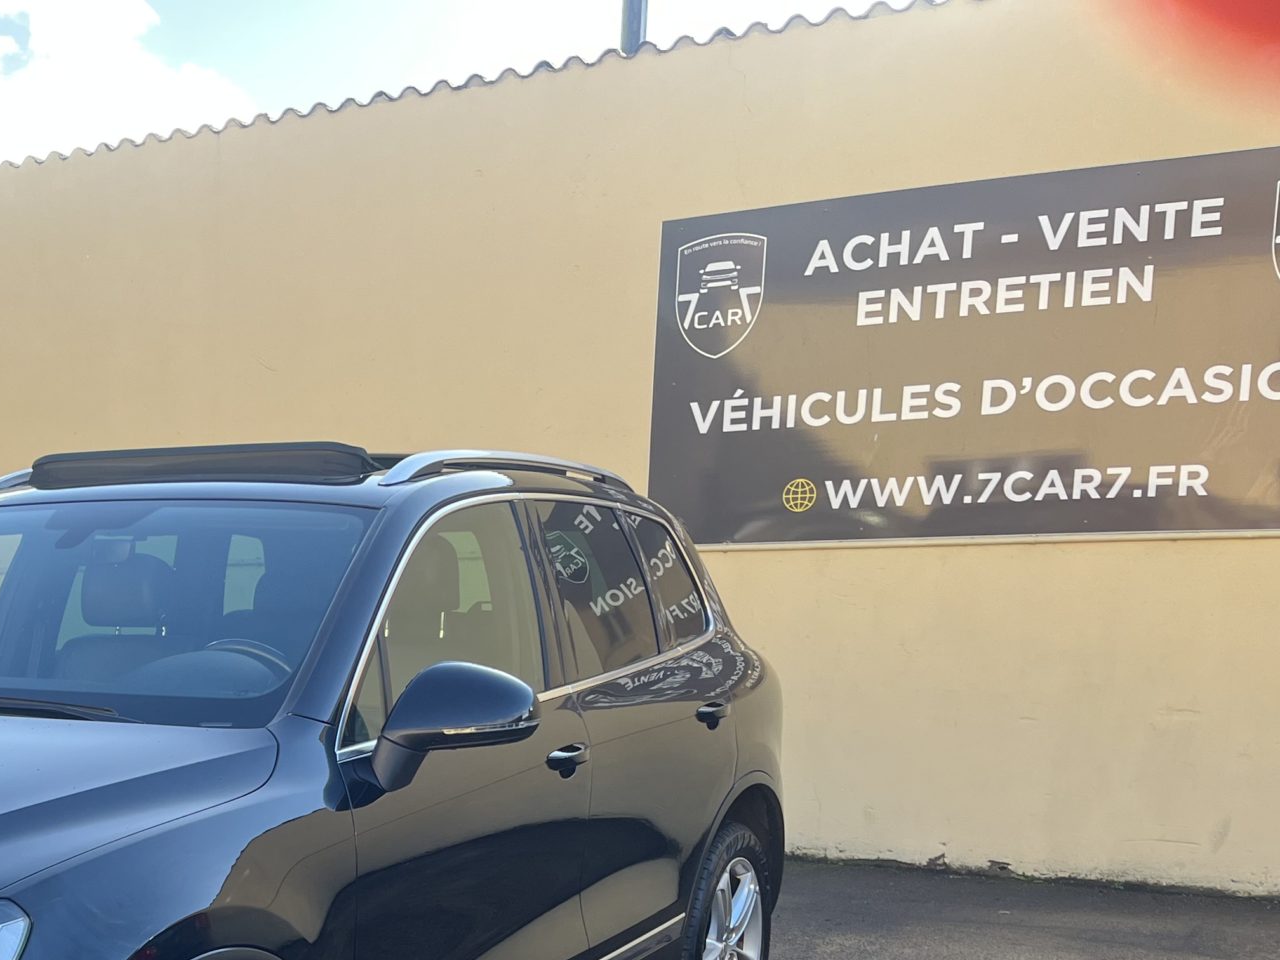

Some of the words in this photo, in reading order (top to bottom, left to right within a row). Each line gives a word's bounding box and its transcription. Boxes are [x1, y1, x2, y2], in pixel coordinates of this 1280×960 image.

[803, 221, 985, 276] ACHAT
[1038, 197, 1225, 251] VENTE
[856, 264, 1155, 327] ENTRETIEN
[689, 381, 962, 434] VÉHICULES
[824, 464, 1209, 509] WWW.7CAR7.FR
